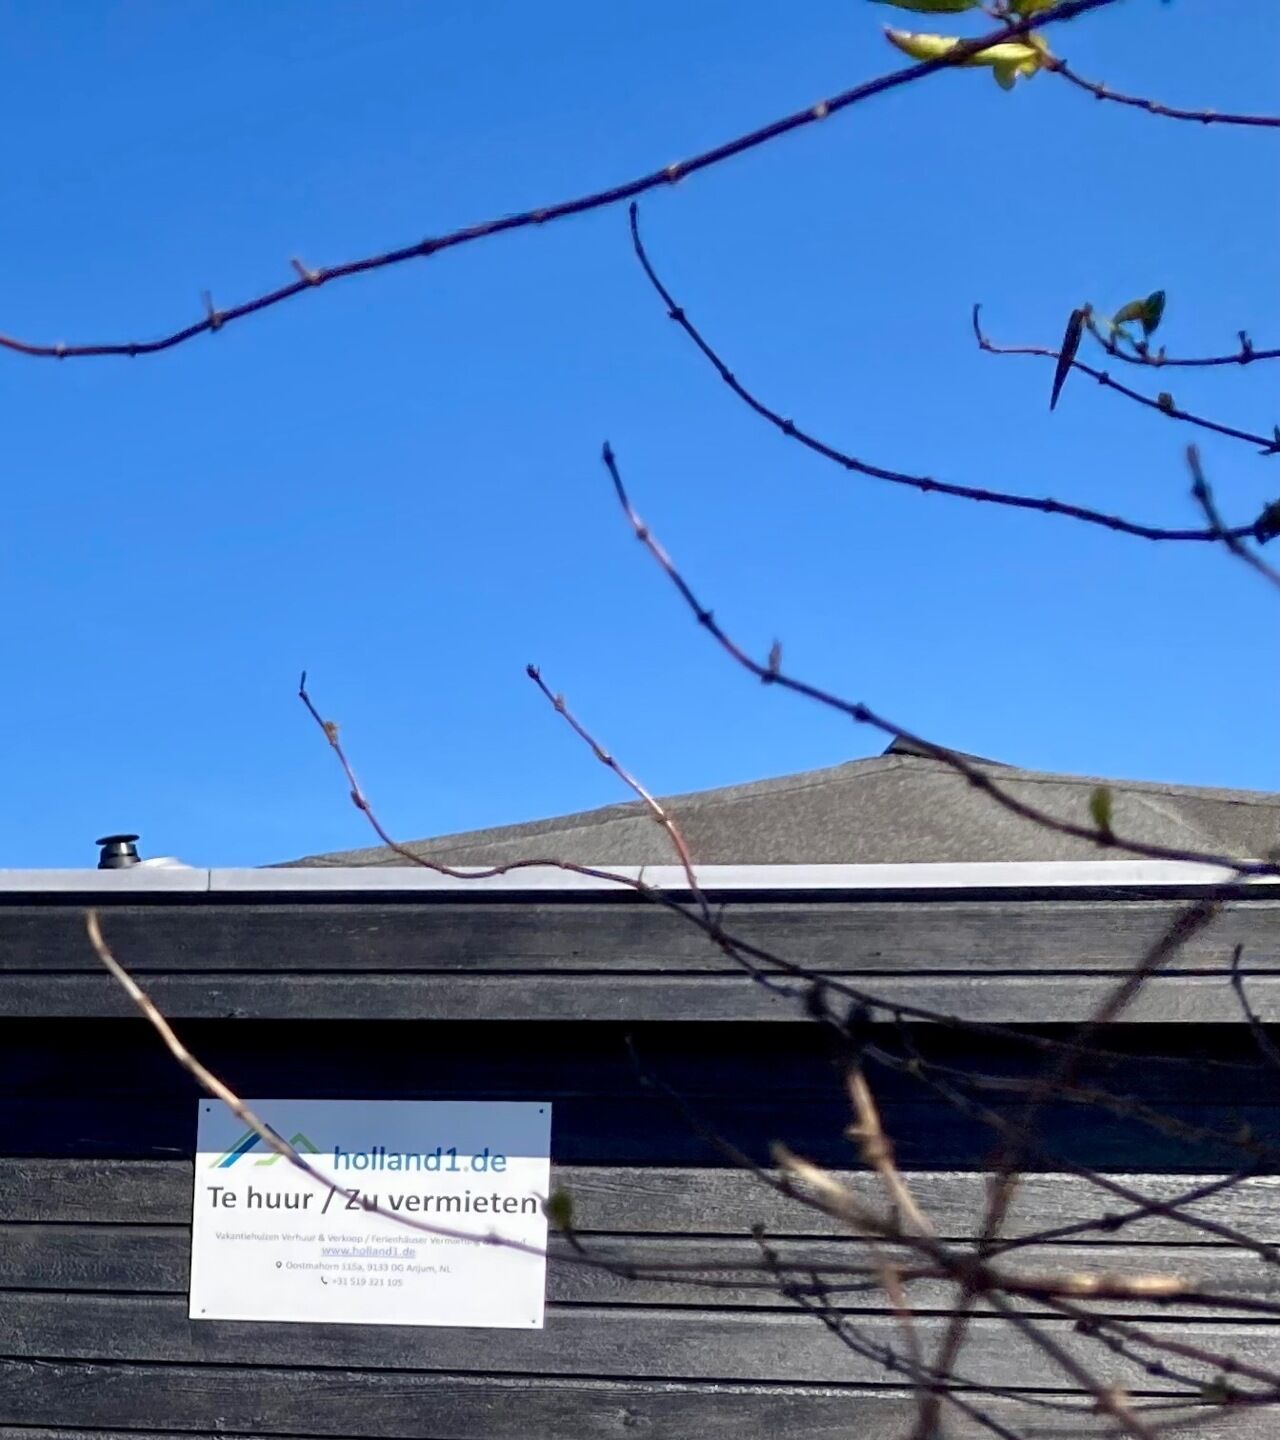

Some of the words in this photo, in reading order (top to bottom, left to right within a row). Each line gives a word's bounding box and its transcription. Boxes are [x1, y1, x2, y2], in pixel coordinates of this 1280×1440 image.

[333, 1146, 507, 1172] holland1.de
[207, 1186, 237, 1208] Te
[247, 1185, 314, 1210] huur
[321, 1185, 336, 1214] /
[344, 1188, 378, 1211] Zu
[389, 1189, 538, 1214] vermieten
[215, 1231, 280, 1241] Vakantiehuizen
[281, 1232, 316, 1242] Verhuur
[328, 1234, 364, 1244] Verkoop
[371, 1235, 428, 1244] Ferienhäuser
[321, 1246, 416, 1258] www.holland1.de
[285, 1261, 340, 1271] Oostmahorn
[350, 1277, 366, 1287] 519
[387, 1278, 404, 1287] 105
